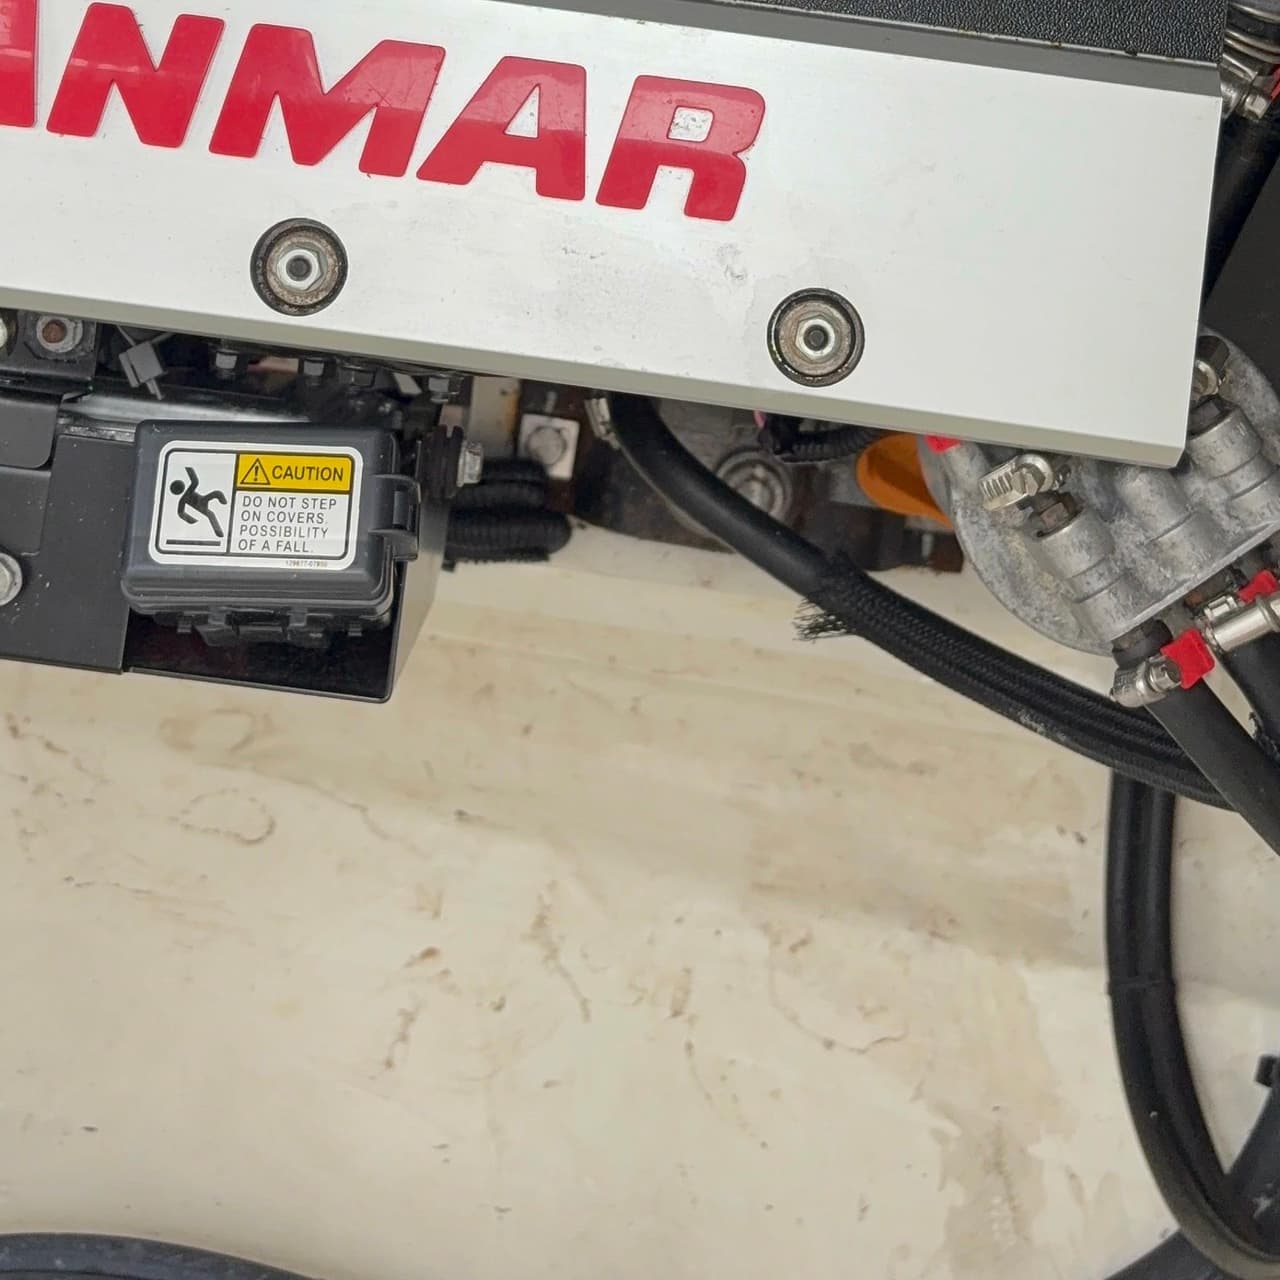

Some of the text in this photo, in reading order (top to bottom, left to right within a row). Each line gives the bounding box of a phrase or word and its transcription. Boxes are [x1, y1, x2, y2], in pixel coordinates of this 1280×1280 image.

[272, 465, 344, 482] CAUTION
[242, 496, 337, 511] DO NOT STEP
[241, 511, 329, 525] ON COVERS.
[239, 525, 329, 539] POSSIBILITY
[238, 539, 315, 553] OF A FALL.
